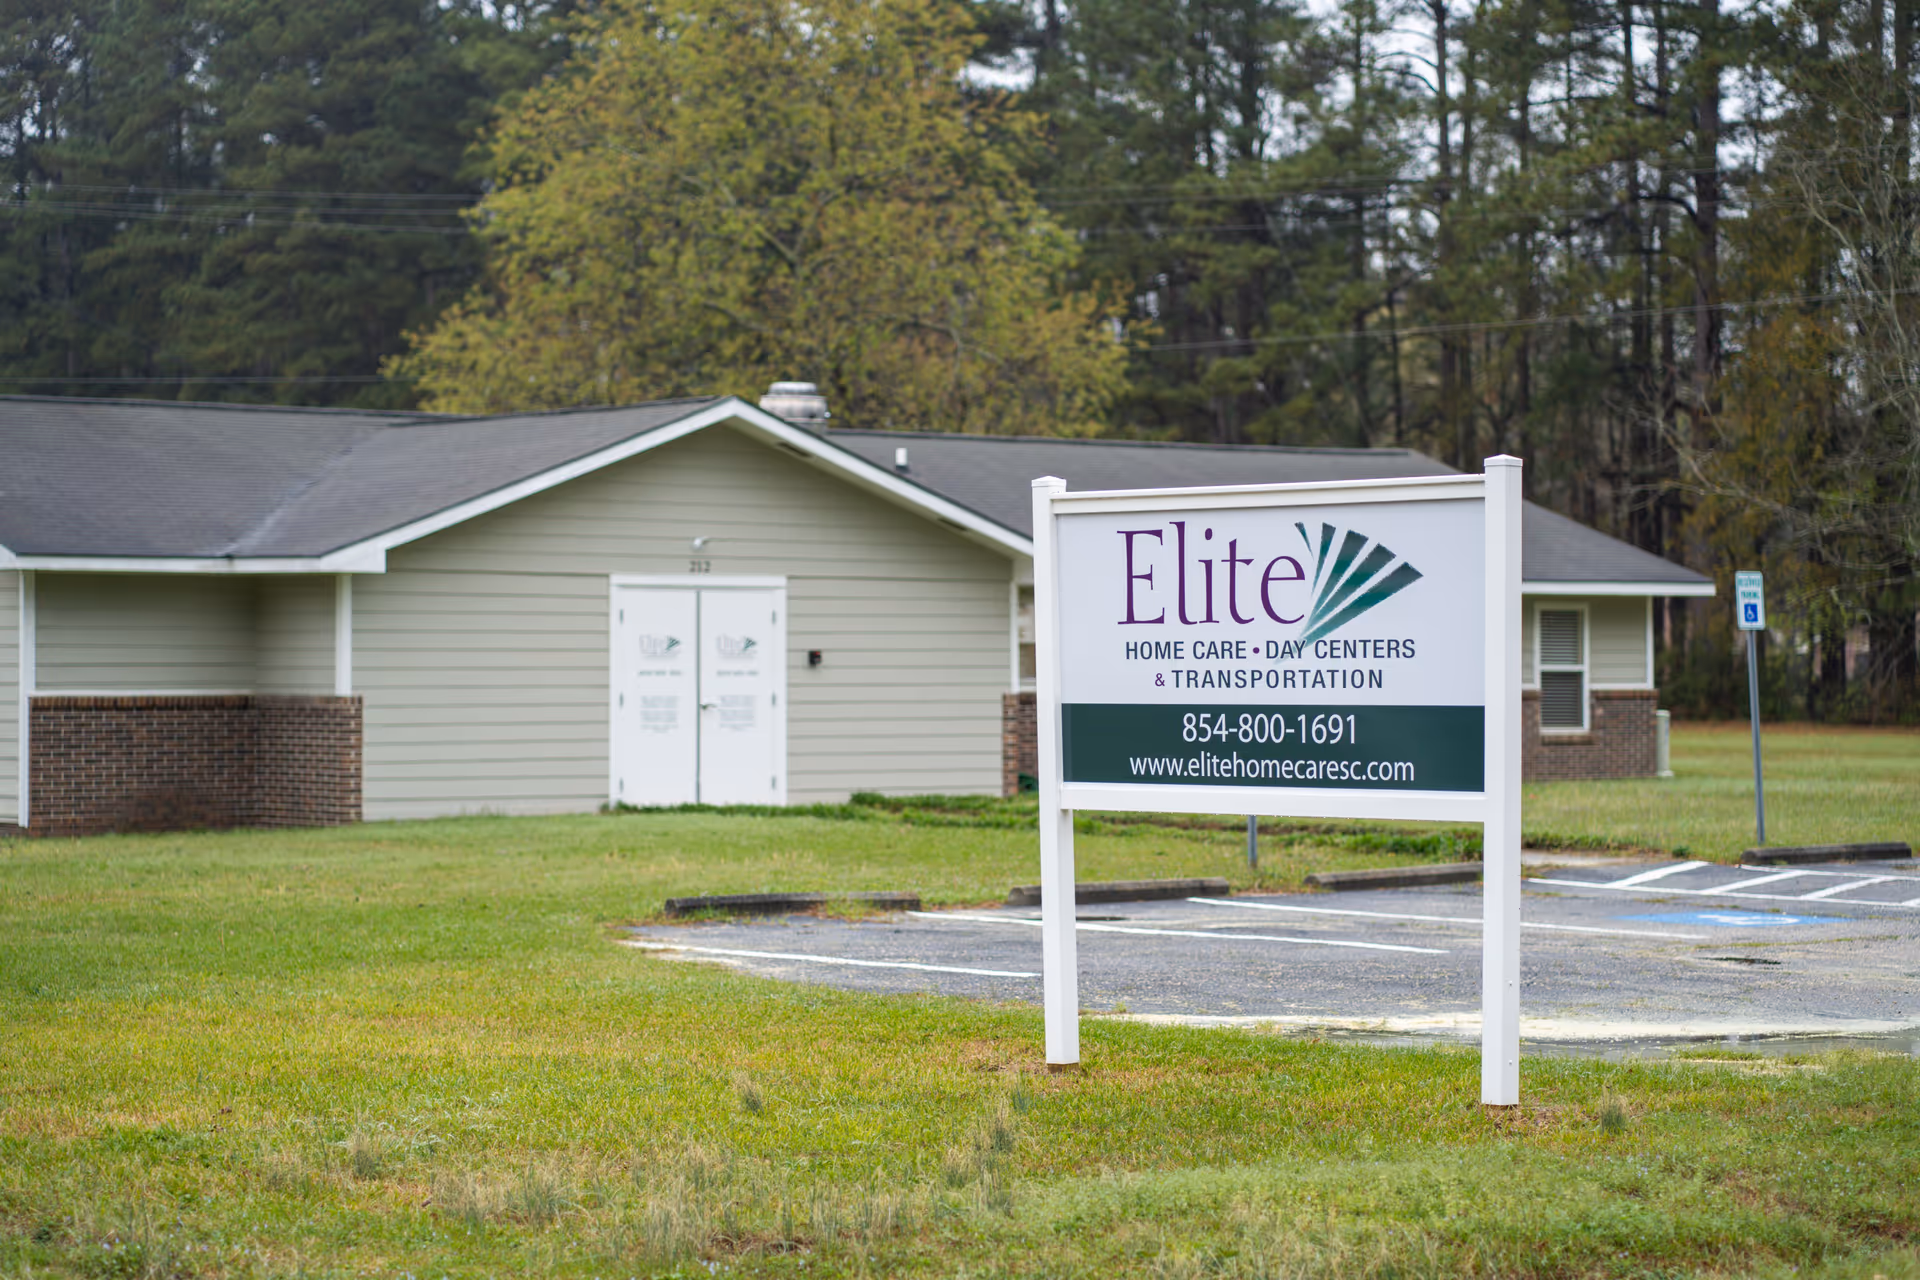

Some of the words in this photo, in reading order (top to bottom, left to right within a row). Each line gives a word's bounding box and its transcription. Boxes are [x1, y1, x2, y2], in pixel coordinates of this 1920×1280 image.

[1117, 521, 1306, 625] Elite
[1125, 640, 1185, 660] HOME
[1192, 640, 1247, 660] CARE
[1265, 640, 1306, 660] DAY
[1314, 638, 1416, 660] CENTERS
[1154, 672, 1166, 687] &
[1171, 668, 1383, 689] TRANSPORTATION
[1182, 712, 1356, 745] 854-800-1691
[1129, 751, 1415, 781] www.elitehomecaresc.com
